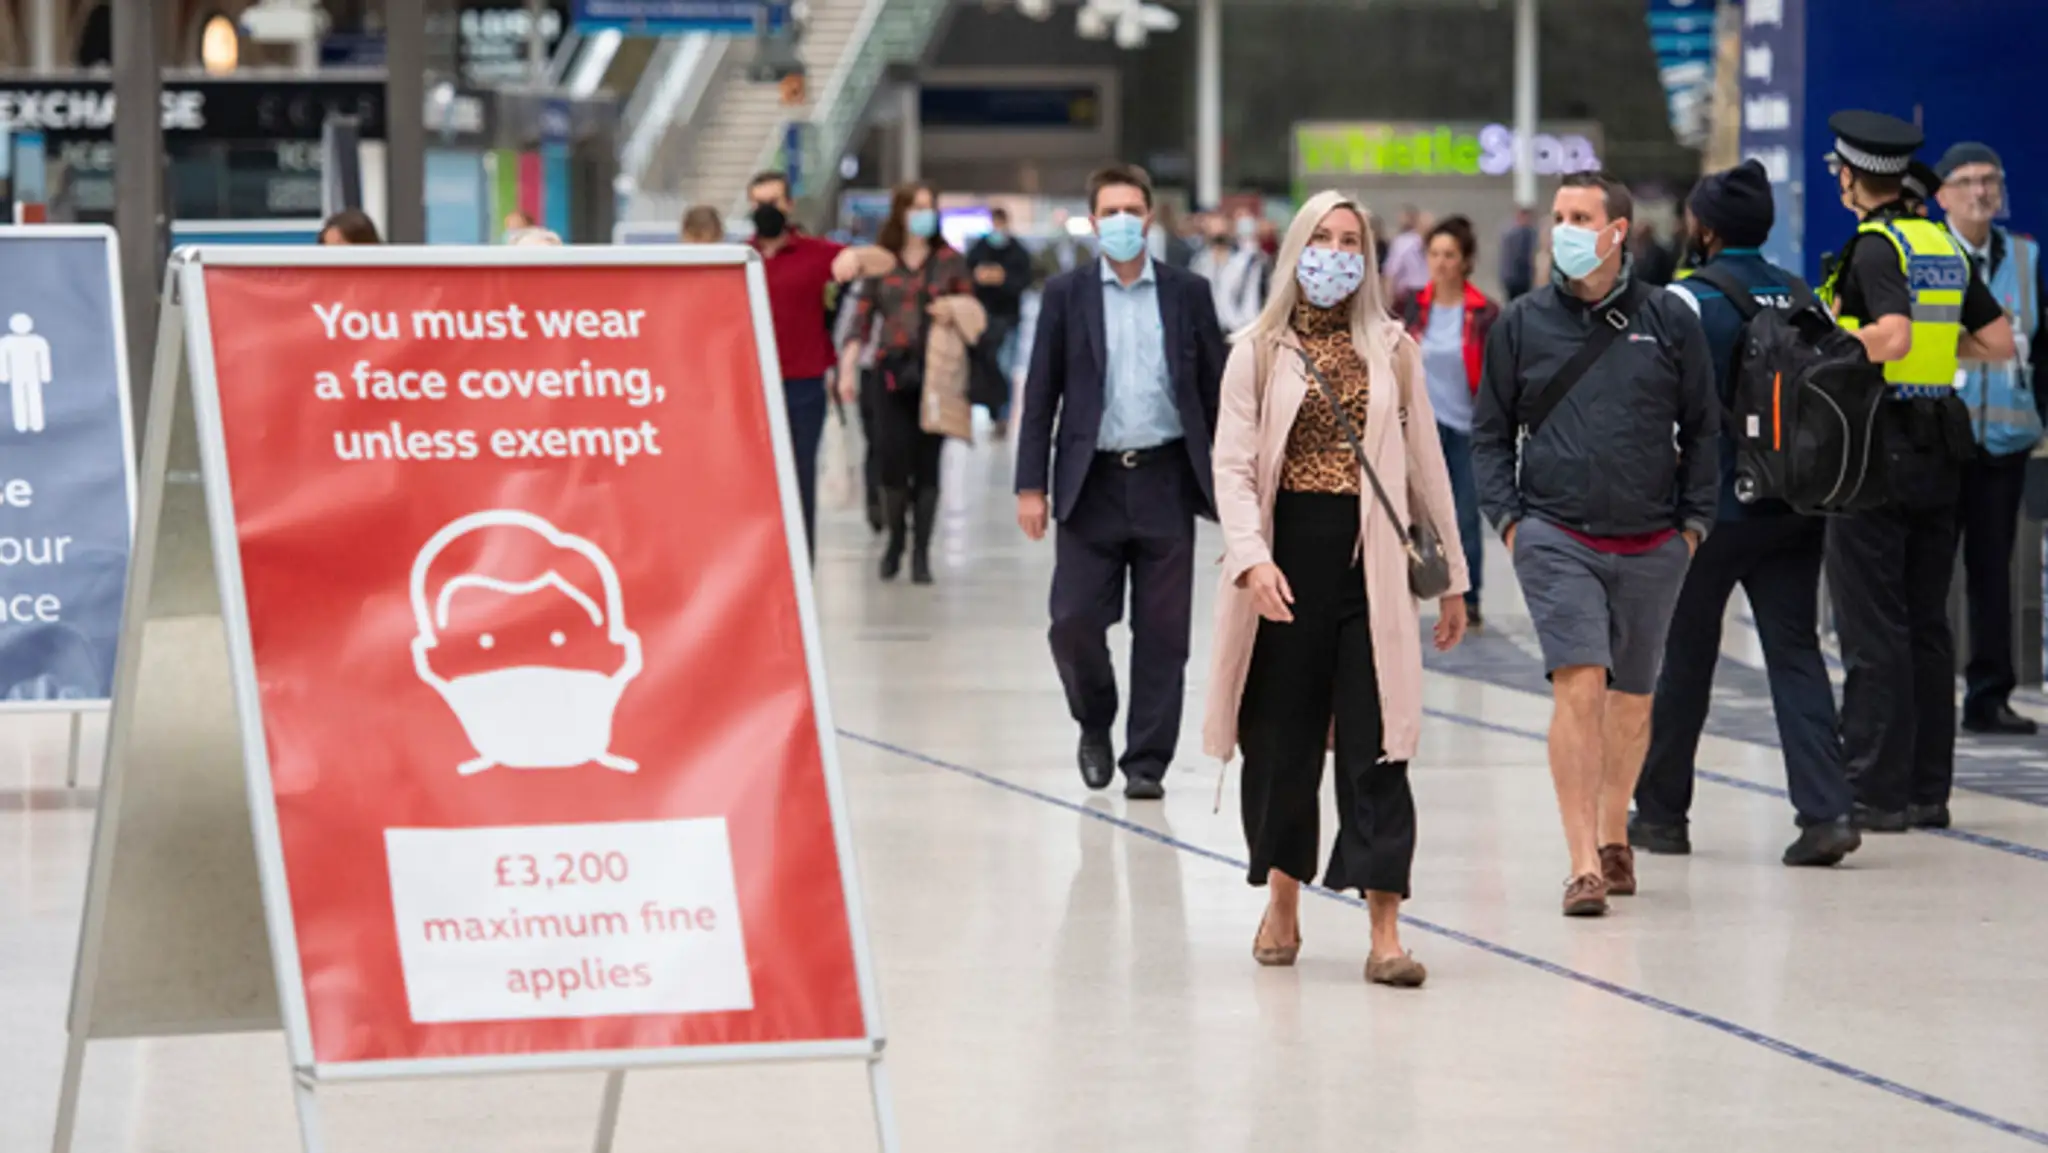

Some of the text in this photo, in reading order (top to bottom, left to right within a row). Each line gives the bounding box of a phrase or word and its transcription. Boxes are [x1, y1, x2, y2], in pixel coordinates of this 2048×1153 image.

[311, 301, 647, 341] You must wear
[314, 358, 667, 408] a face covering,
[332, 420, 664, 467] unless exempt
[493, 850, 630, 889] £3,200
[422, 901, 718, 944] maximum fine
[505, 957, 653, 1001] applies
